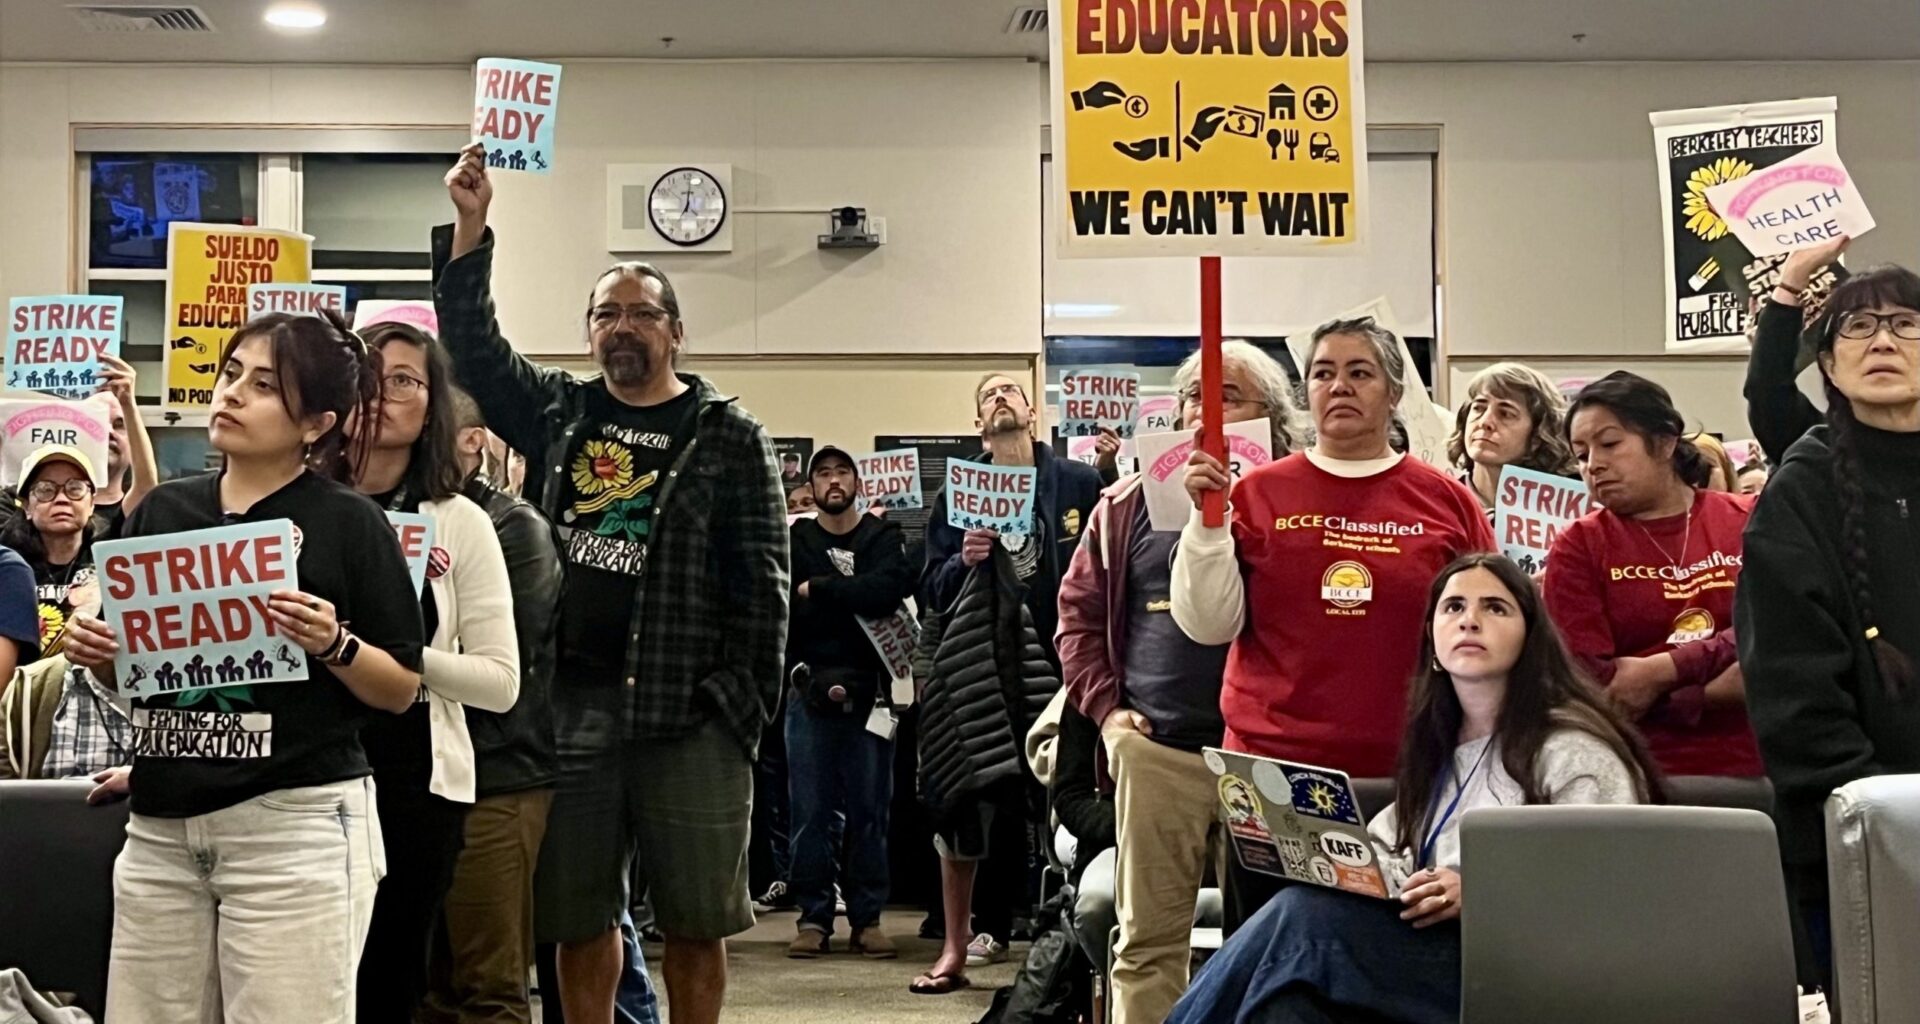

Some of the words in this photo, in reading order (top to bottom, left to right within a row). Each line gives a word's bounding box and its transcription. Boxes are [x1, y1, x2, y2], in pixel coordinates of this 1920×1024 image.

[1076, 0, 1349, 57] EDUCATORS
[479, 68, 554, 106] TRIKE
[1670, 128, 1740, 158] BERKELEY
[1746, 124, 1819, 148] TEACHERS
[1069, 190, 1130, 236] WE
[1143, 190, 1248, 236] CAN'T
[1258, 191, 1349, 237] WAIT
[1746, 188, 1843, 231] HEALTH
[1776, 219, 1843, 246] CARE
[205, 235, 279, 262] SUELDO
[210, 261, 273, 285] JUSTO
[206, 285, 247, 305] PARA
[252, 289, 342, 314] STRIKE
[1709, 291, 1742, 312] FIGH
[13, 304, 117, 333] STRIKE
[178, 303, 248, 329] EDUCA
[1680, 306, 1736, 335] PUBLIC
[15, 336, 110, 366] READY
[168, 388, 185, 404] NO
[1063, 375, 1138, 398] STRIKE
[1066, 399, 1133, 422] READY
[1147, 416, 1172, 429] FAI
[31, 428, 77, 446] FAIR
[858, 453, 915, 477] TRIKE
[951, 464, 1032, 495] STRIKE
[953, 490, 1026, 519] READY
[1275, 515, 1424, 536] BCCEClassified
[1505, 513, 1556, 551] REA
[105, 535, 285, 600] STRIKE
[582, 550, 645, 577] EDUCATIO
[121, 593, 280, 655] READY
[867, 619, 911, 680] STRIK
[213, 713, 245, 731] FOR
[1324, 837, 1363, 861] KAFF
